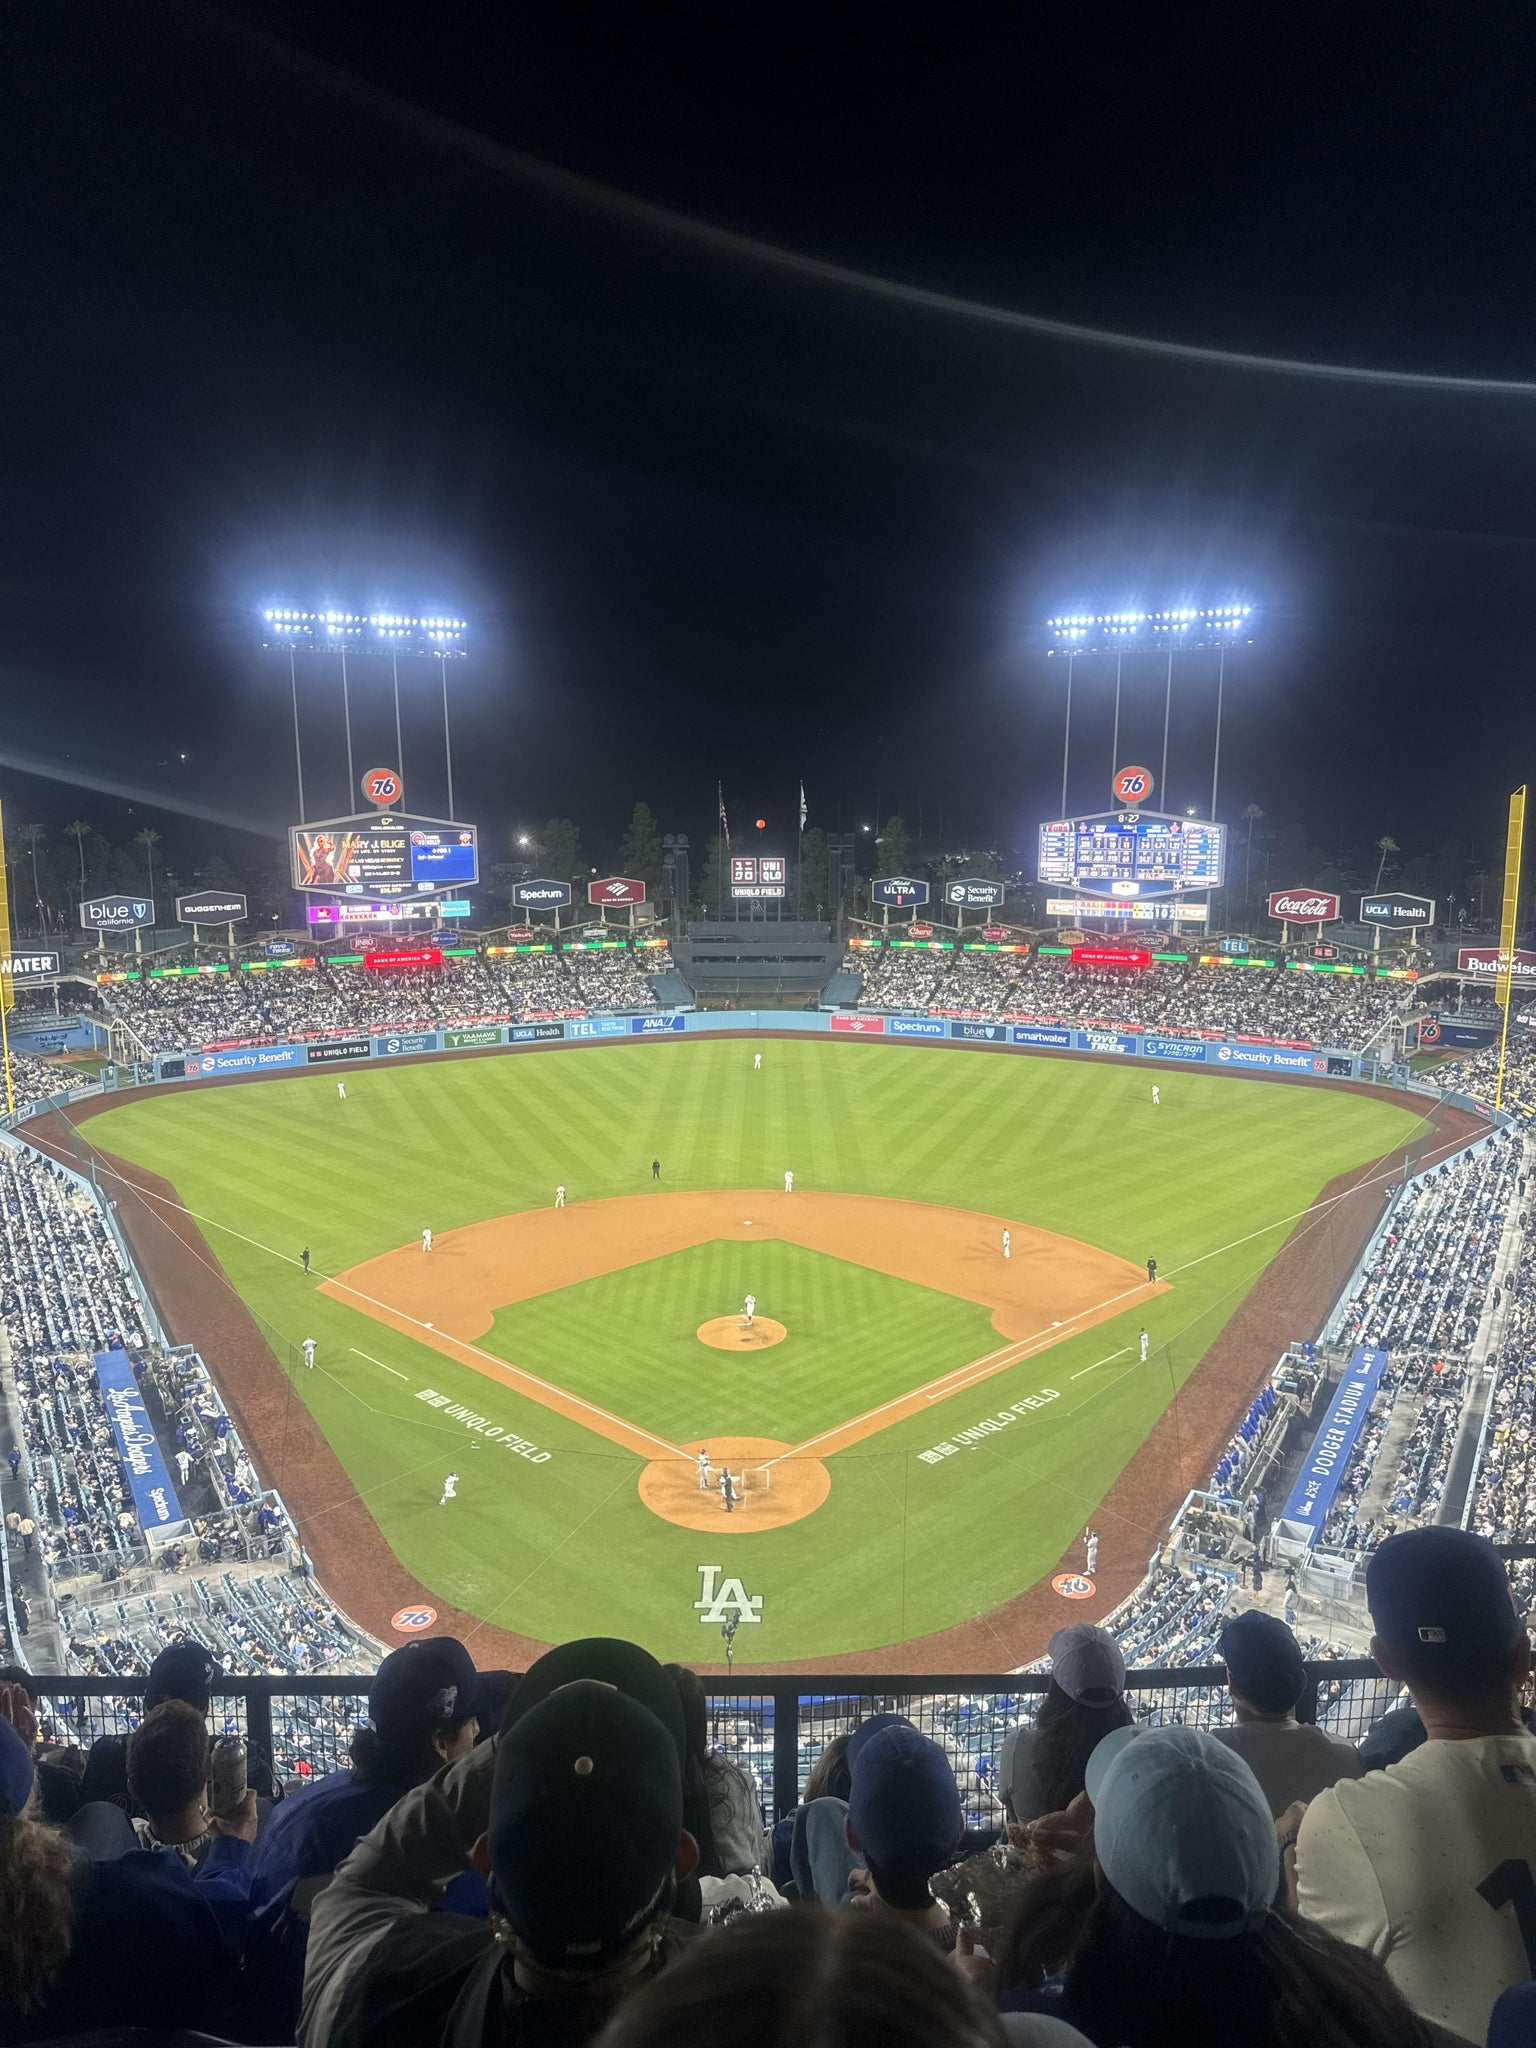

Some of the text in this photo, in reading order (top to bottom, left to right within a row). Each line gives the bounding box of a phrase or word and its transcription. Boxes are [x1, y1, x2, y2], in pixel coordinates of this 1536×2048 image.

[372, 777, 396, 796] 76
[1121, 774, 1144, 794] 76
[1118, 814, 1140, 823] 8:27
[342, 840, 368, 849] MARY
[381, 840, 406, 849] BLIGE
[762, 862, 780, 871] UNI
[763, 871, 782, 882] QLO
[520, 889, 562, 900] Spectrum
[734, 888, 782, 897] UNIQLO FIELD
[884, 887, 916, 895] ULTRA
[967, 886, 998, 896] Security
[968, 895, 993, 903] Benefit
[90, 903, 129, 919] blue
[184, 903, 242, 913] GUGGENHEIM
[1275, 896, 1331, 916] Coca-Cola
[1366, 905, 1426, 918] UCLA Health
[97, 917, 134, 926] california
[355, 939, 374, 948] JINRO
[1223, 941, 1245, 952] TEL
[642, 1018, 664, 1028] ANA
[894, 1021, 938, 1033] Spectrum
[516, 1027, 560, 1038] UCLA Health
[571, 1024, 597, 1036] TEL
[963, 1025, 985, 1036] blue
[402, 1037, 427, 1047] Security
[1015, 1032, 1068, 1044] smartwater
[1086, 1034, 1118, 1044] TOYO
[323, 1046, 369, 1057] UNIQLO FIELD
[402, 1044, 424, 1052] Benefit
[1090, 1042, 1125, 1052] TIRES
[1157, 1042, 1203, 1053] SYNCRON
[217, 1051, 292, 1068] Security Benefit
[1233, 1050, 1309, 1067] Security Benefit
[187, 1064, 198, 1072] 76
[1313, 1060, 1324, 1069] 76
[112, 1403, 145, 1436] Angeles
[951, 1388, 1061, 1445] UNIQLO FIELD
[444, 1403, 552, 1464] UNIQLO FIELD
[1311, 1427, 1347, 1476] DODGER
[1333, 1381, 1366, 1425] STADIUM
[123, 1434, 155, 1475] Dodgers
[148, 1487, 170, 1521] Spectrum
[693, 1565, 764, 1623] LA
[394, 1609, 434, 1627] 76
